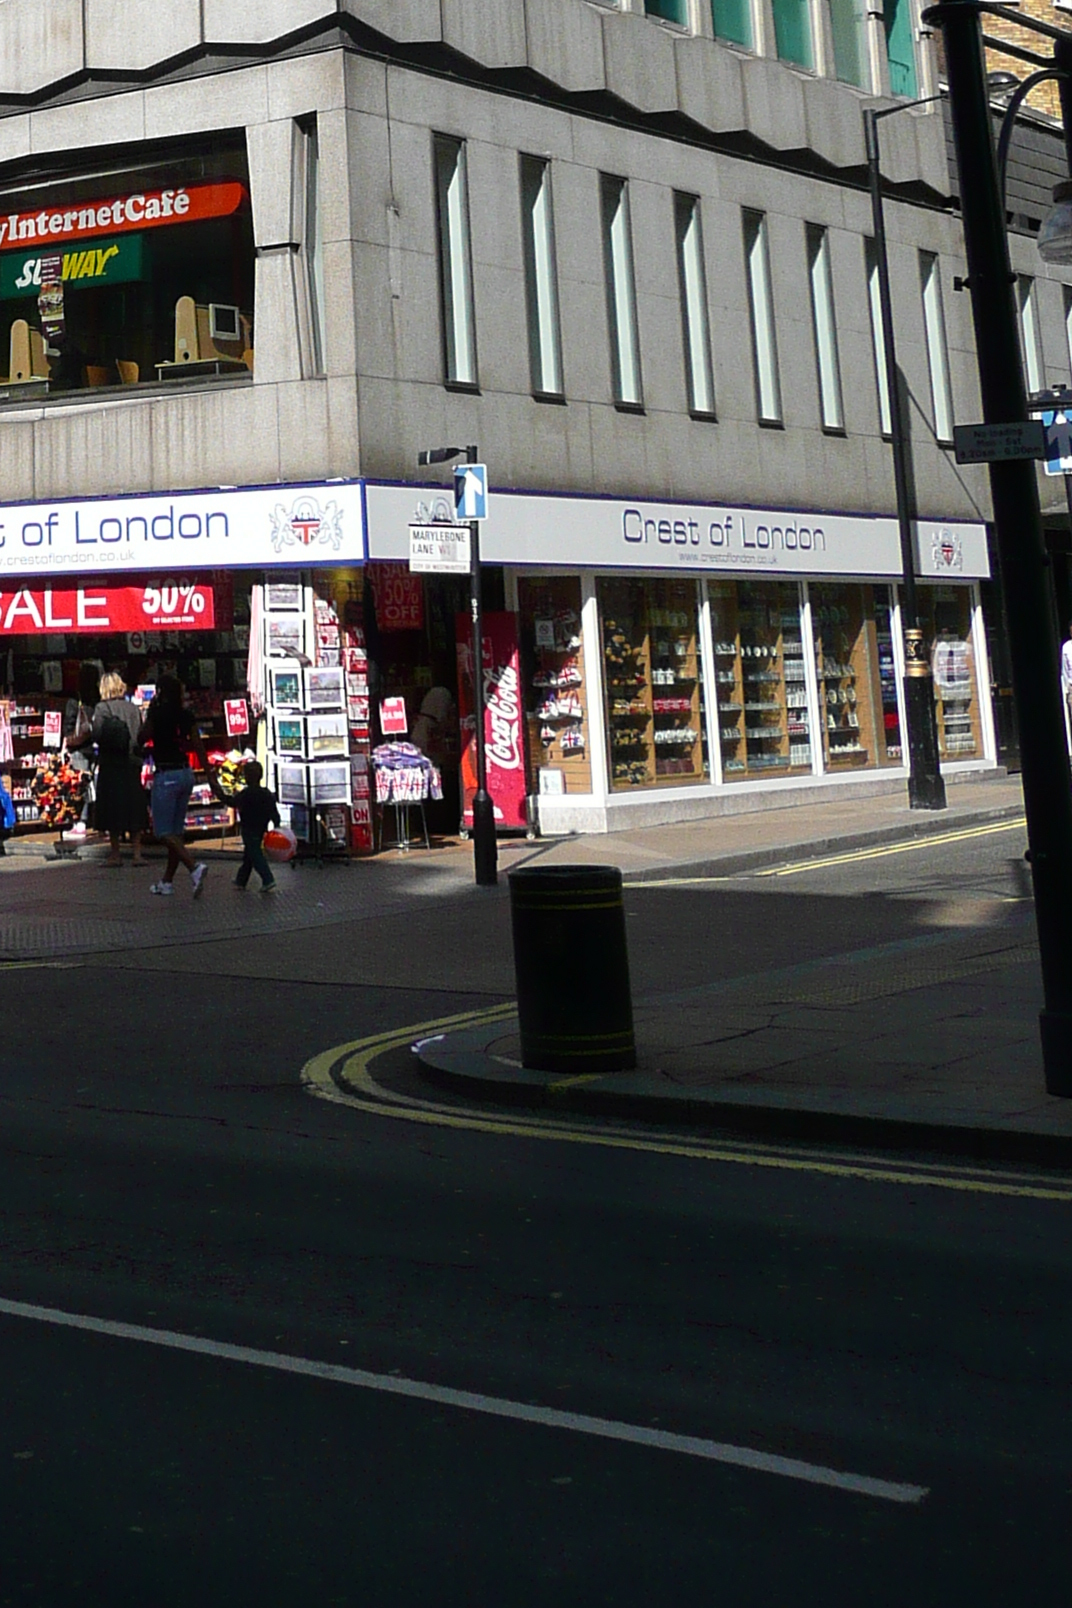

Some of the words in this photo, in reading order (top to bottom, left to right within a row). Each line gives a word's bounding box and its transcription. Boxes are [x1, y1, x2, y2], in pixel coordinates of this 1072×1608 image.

[22, 513, 59, 547] of
[74, 505, 230, 546] London
[412, 530, 466, 543] MARYLEBONE
[622, 509, 700, 546] Crest
[710, 516, 733, 547] of
[743, 517, 827, 552] London
[412, 543, 434, 555] LANE
[141, 576, 206, 616] 50%
[385, 579, 420, 605] 50%
[384, 605, 420, 620] OFF
